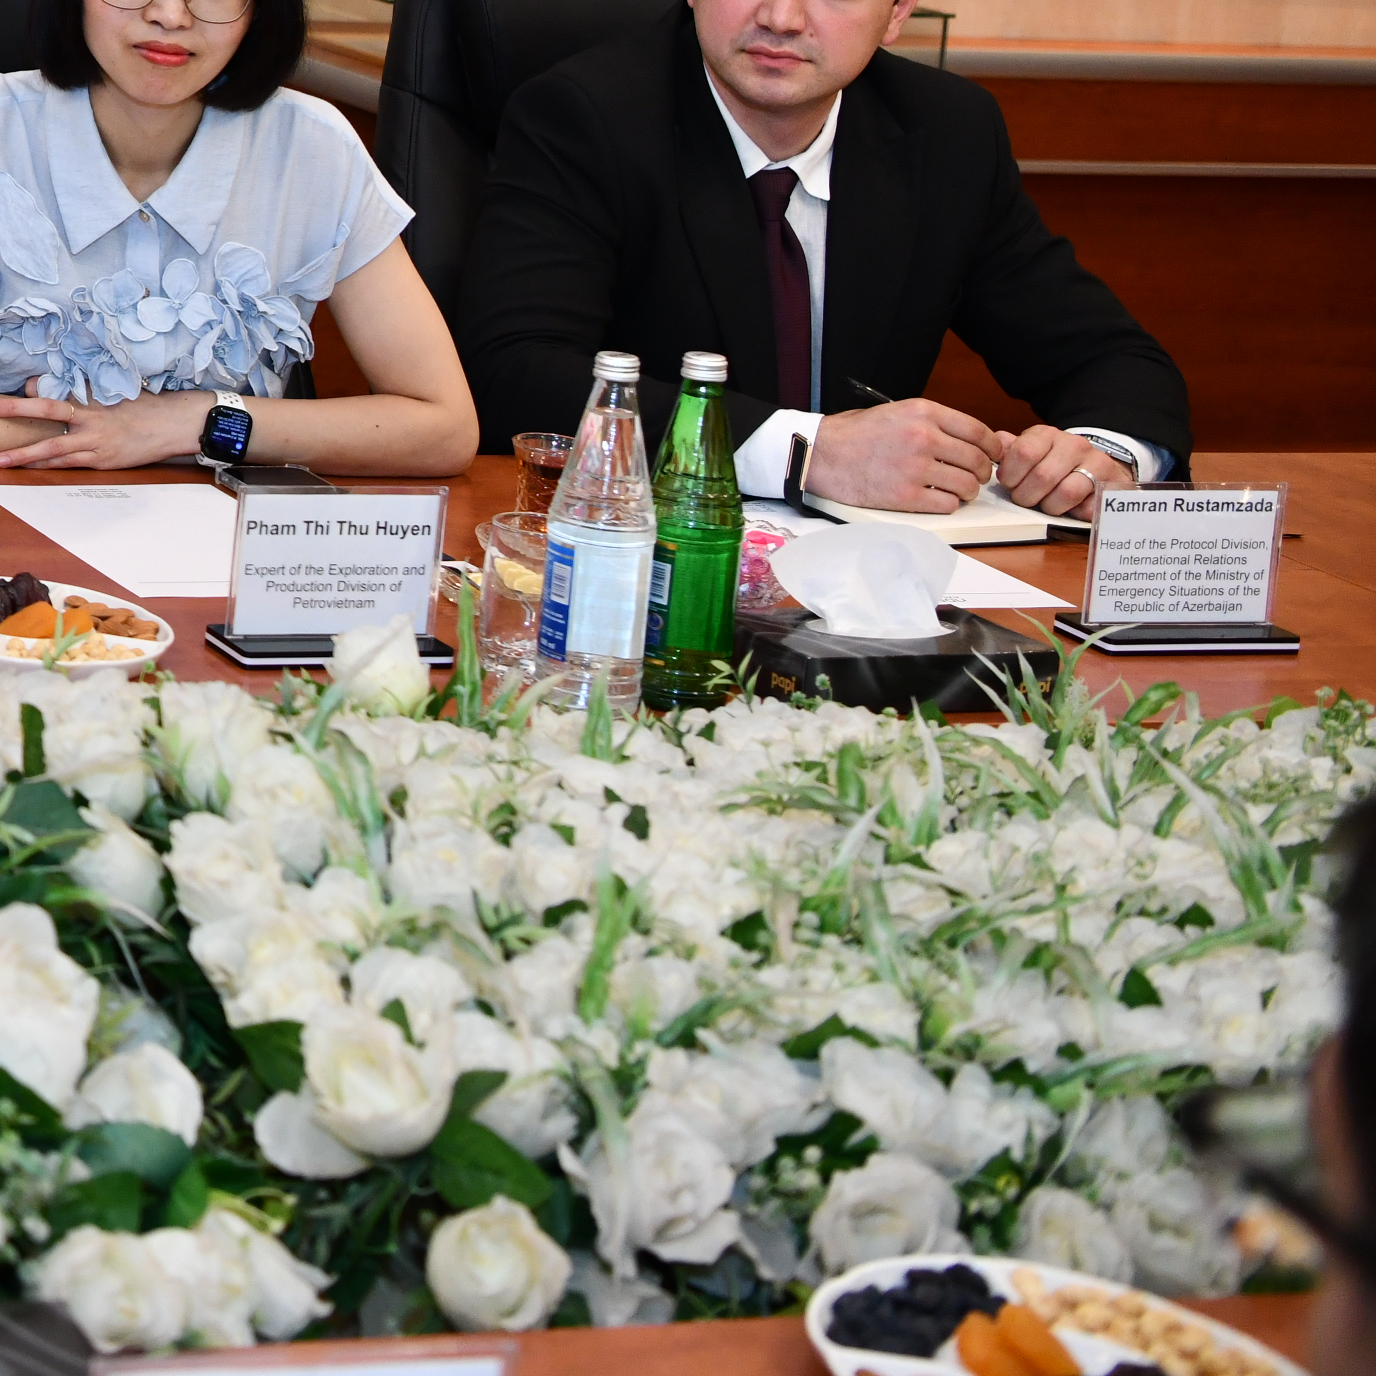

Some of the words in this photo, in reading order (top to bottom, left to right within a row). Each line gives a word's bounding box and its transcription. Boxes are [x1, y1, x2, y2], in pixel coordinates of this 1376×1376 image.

[1104, 498, 1167, 513] Kamran
[1173, 498, 1273, 513] Rustamzada
[246, 520, 296, 536] Pham
[303, 520, 330, 536] Thi
[337, 521, 369, 536] Thu
[375, 521, 432, 539] Huyen
[1100, 539, 1130, 550] Head
[1135, 539, 1147, 550] of
[1149, 539, 1166, 550] the
[1170, 539, 1217, 550] Protocol
[1221, 539, 1268, 552] Division,
[1119, 554, 1190, 565] International
[1194, 554, 1247, 565] Relations
[244, 564, 286, 578] Expert
[289, 564, 303, 575] of
[305, 564, 324, 575] the
[329, 564, 398, 578] Exploration
[402, 564, 426, 575] and
[1098, 570, 1166, 583] Department
[1171, 569, 1183, 581] of
[1184, 569, 1201, 581] the
[1205, 569, 1250, 583] Ministry
[1254, 569, 1265, 581] of
[266, 580, 332, 592] Production
[337, 580, 386, 592] Division
[389, 580, 403, 592] of
[1099, 586, 1165, 598] Emergency
[1169, 585, 1224, 596] Situations
[1228, 585, 1240, 596] of
[1243, 585, 1260, 596] the
[293, 597, 375, 609] Petrovietnam
[1114, 600, 1165, 613] Republic
[1168, 600, 1180, 612] of
[1182, 600, 1243, 614] Azerbaijan
[771, 672, 796, 695] papi
